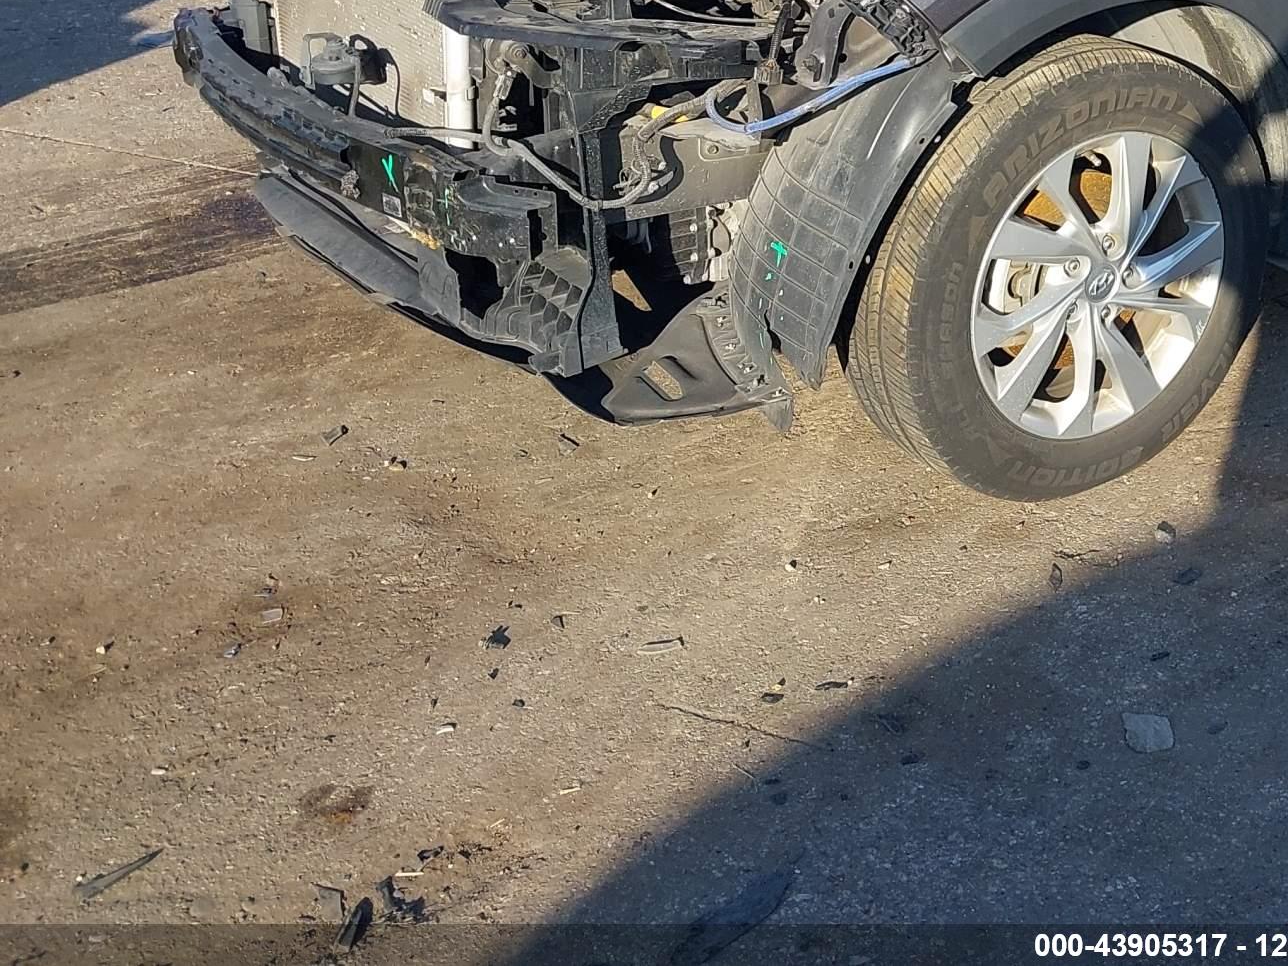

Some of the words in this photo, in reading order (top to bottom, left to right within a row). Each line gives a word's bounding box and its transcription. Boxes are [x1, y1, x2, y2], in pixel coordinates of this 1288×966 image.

[981, 86, 1179, 209] ARIZONIAN
[939, 260, 965, 380] SEASON
[1007, 446, 1145, 489] EDITION
